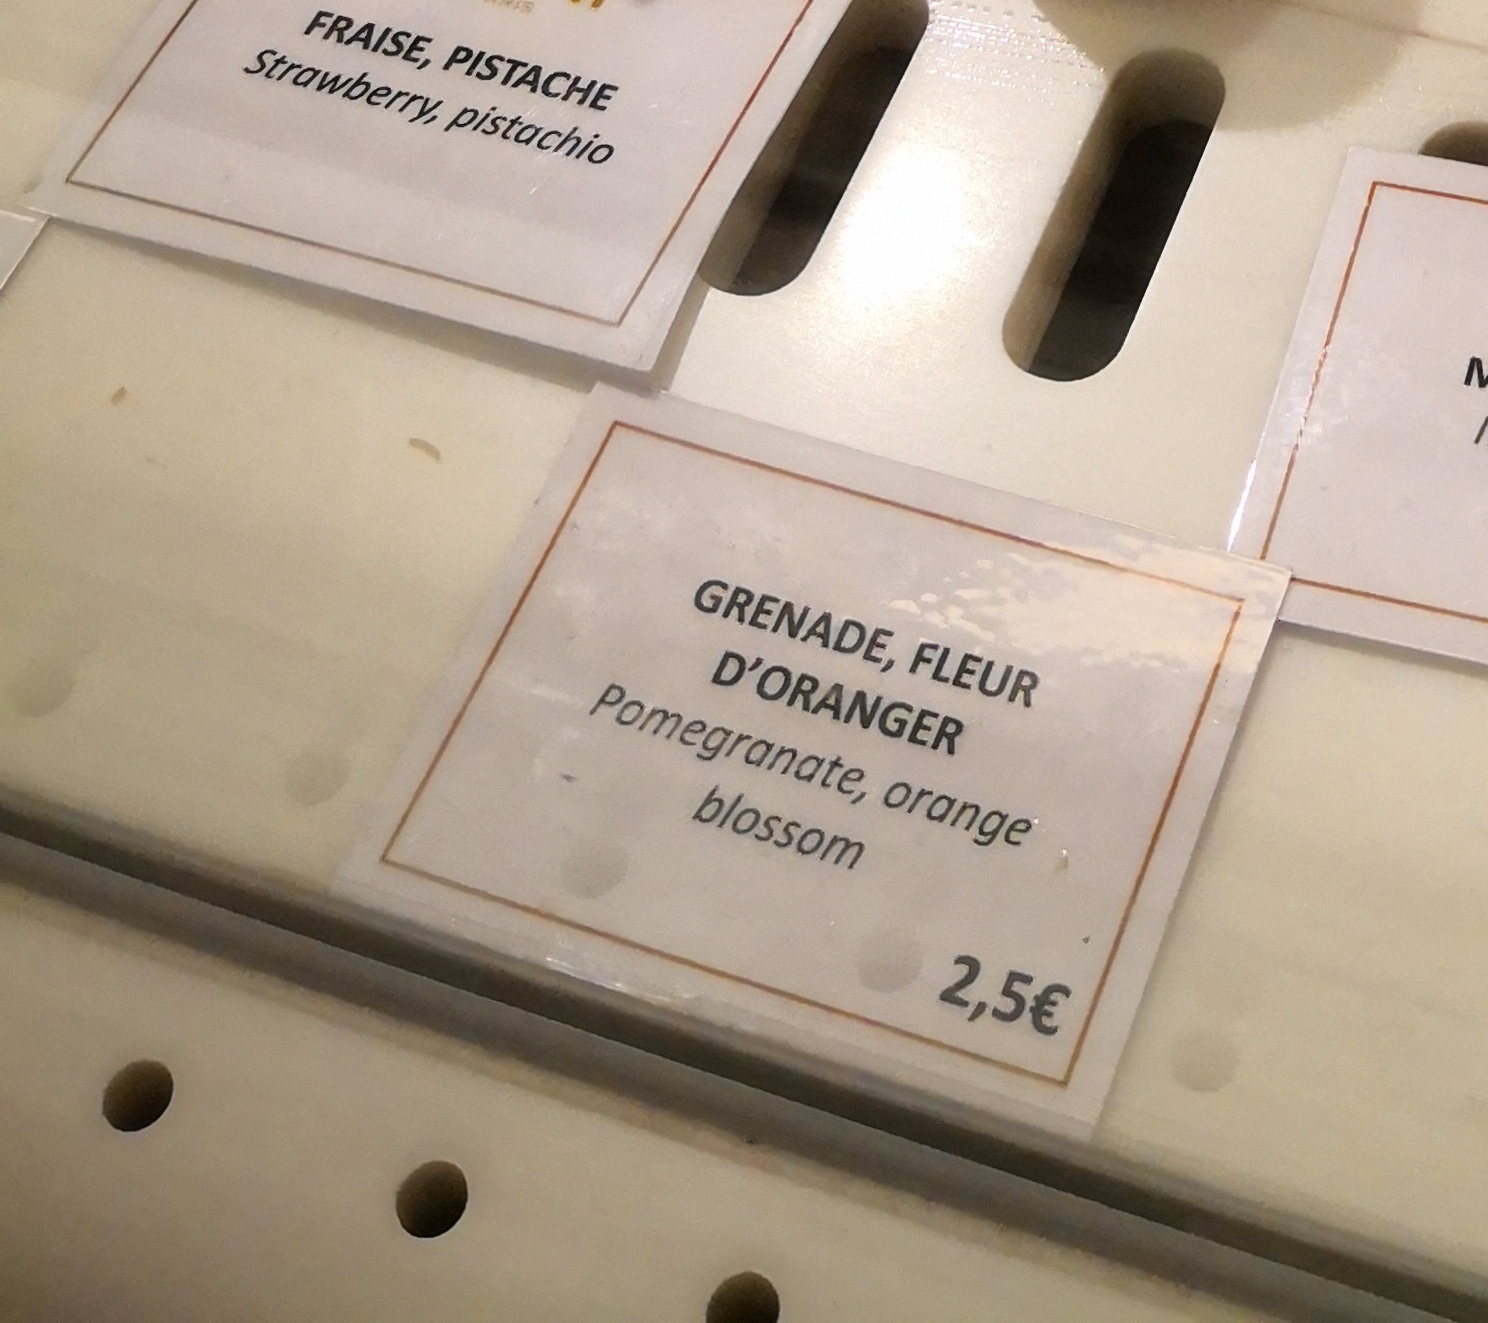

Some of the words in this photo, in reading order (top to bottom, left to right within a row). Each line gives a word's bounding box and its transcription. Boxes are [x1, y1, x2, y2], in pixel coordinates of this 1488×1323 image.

[242, 49, 444, 125] Strawberry,
[444, 106, 615, 164] pistachio
[302, 10, 433, 70] FRAISE,
[443, 45, 620, 112] PISTACHE
[693, 579, 895, 673] GRENADE,
[908, 642, 1040, 709] FLEUR
[710, 650, 965, 757] D'ORANGER
[589, 683, 867, 805] Pomegranate,
[882, 782, 1033, 847] orange
[691, 786, 865, 870] blossom
[938, 955, 1072, 1037] 2,5€
